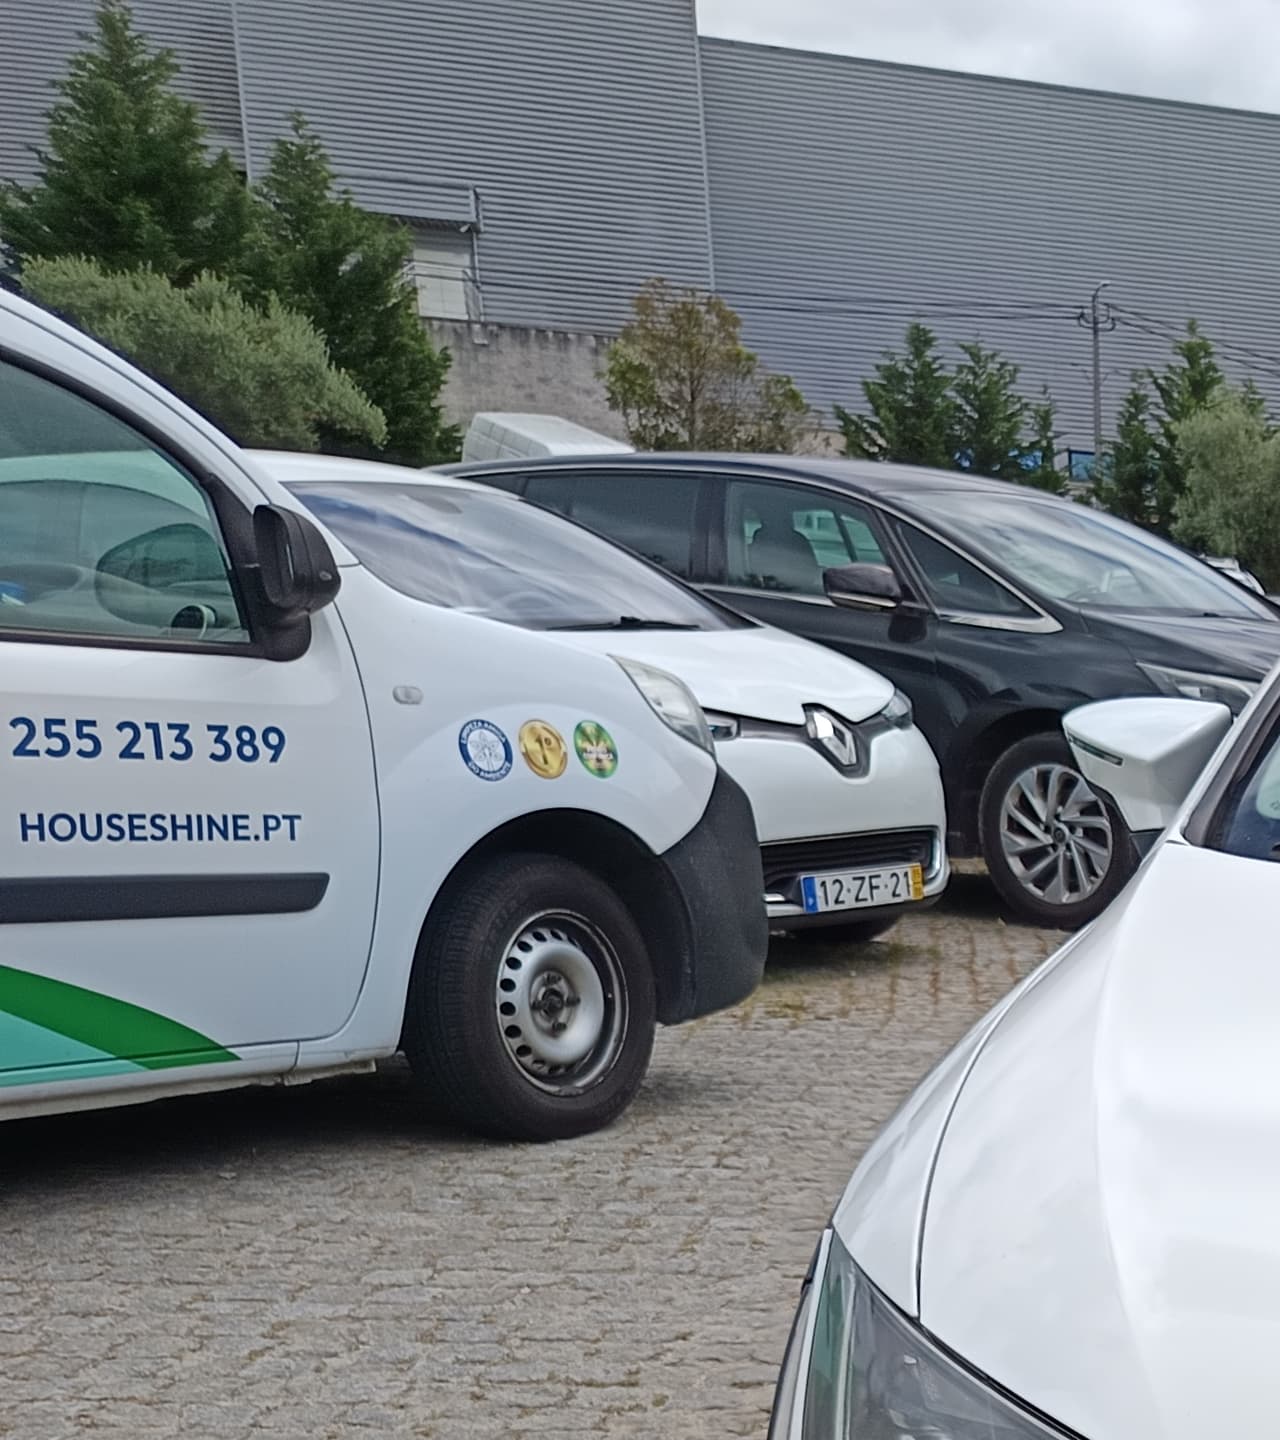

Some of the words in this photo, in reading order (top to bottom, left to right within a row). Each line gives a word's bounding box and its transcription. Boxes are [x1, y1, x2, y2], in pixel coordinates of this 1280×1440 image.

[9, 717, 102, 758] 255
[115, 721, 193, 761] 213
[206, 724, 286, 763] 389
[20, 813, 302, 842] HOUSESHINE.PT
